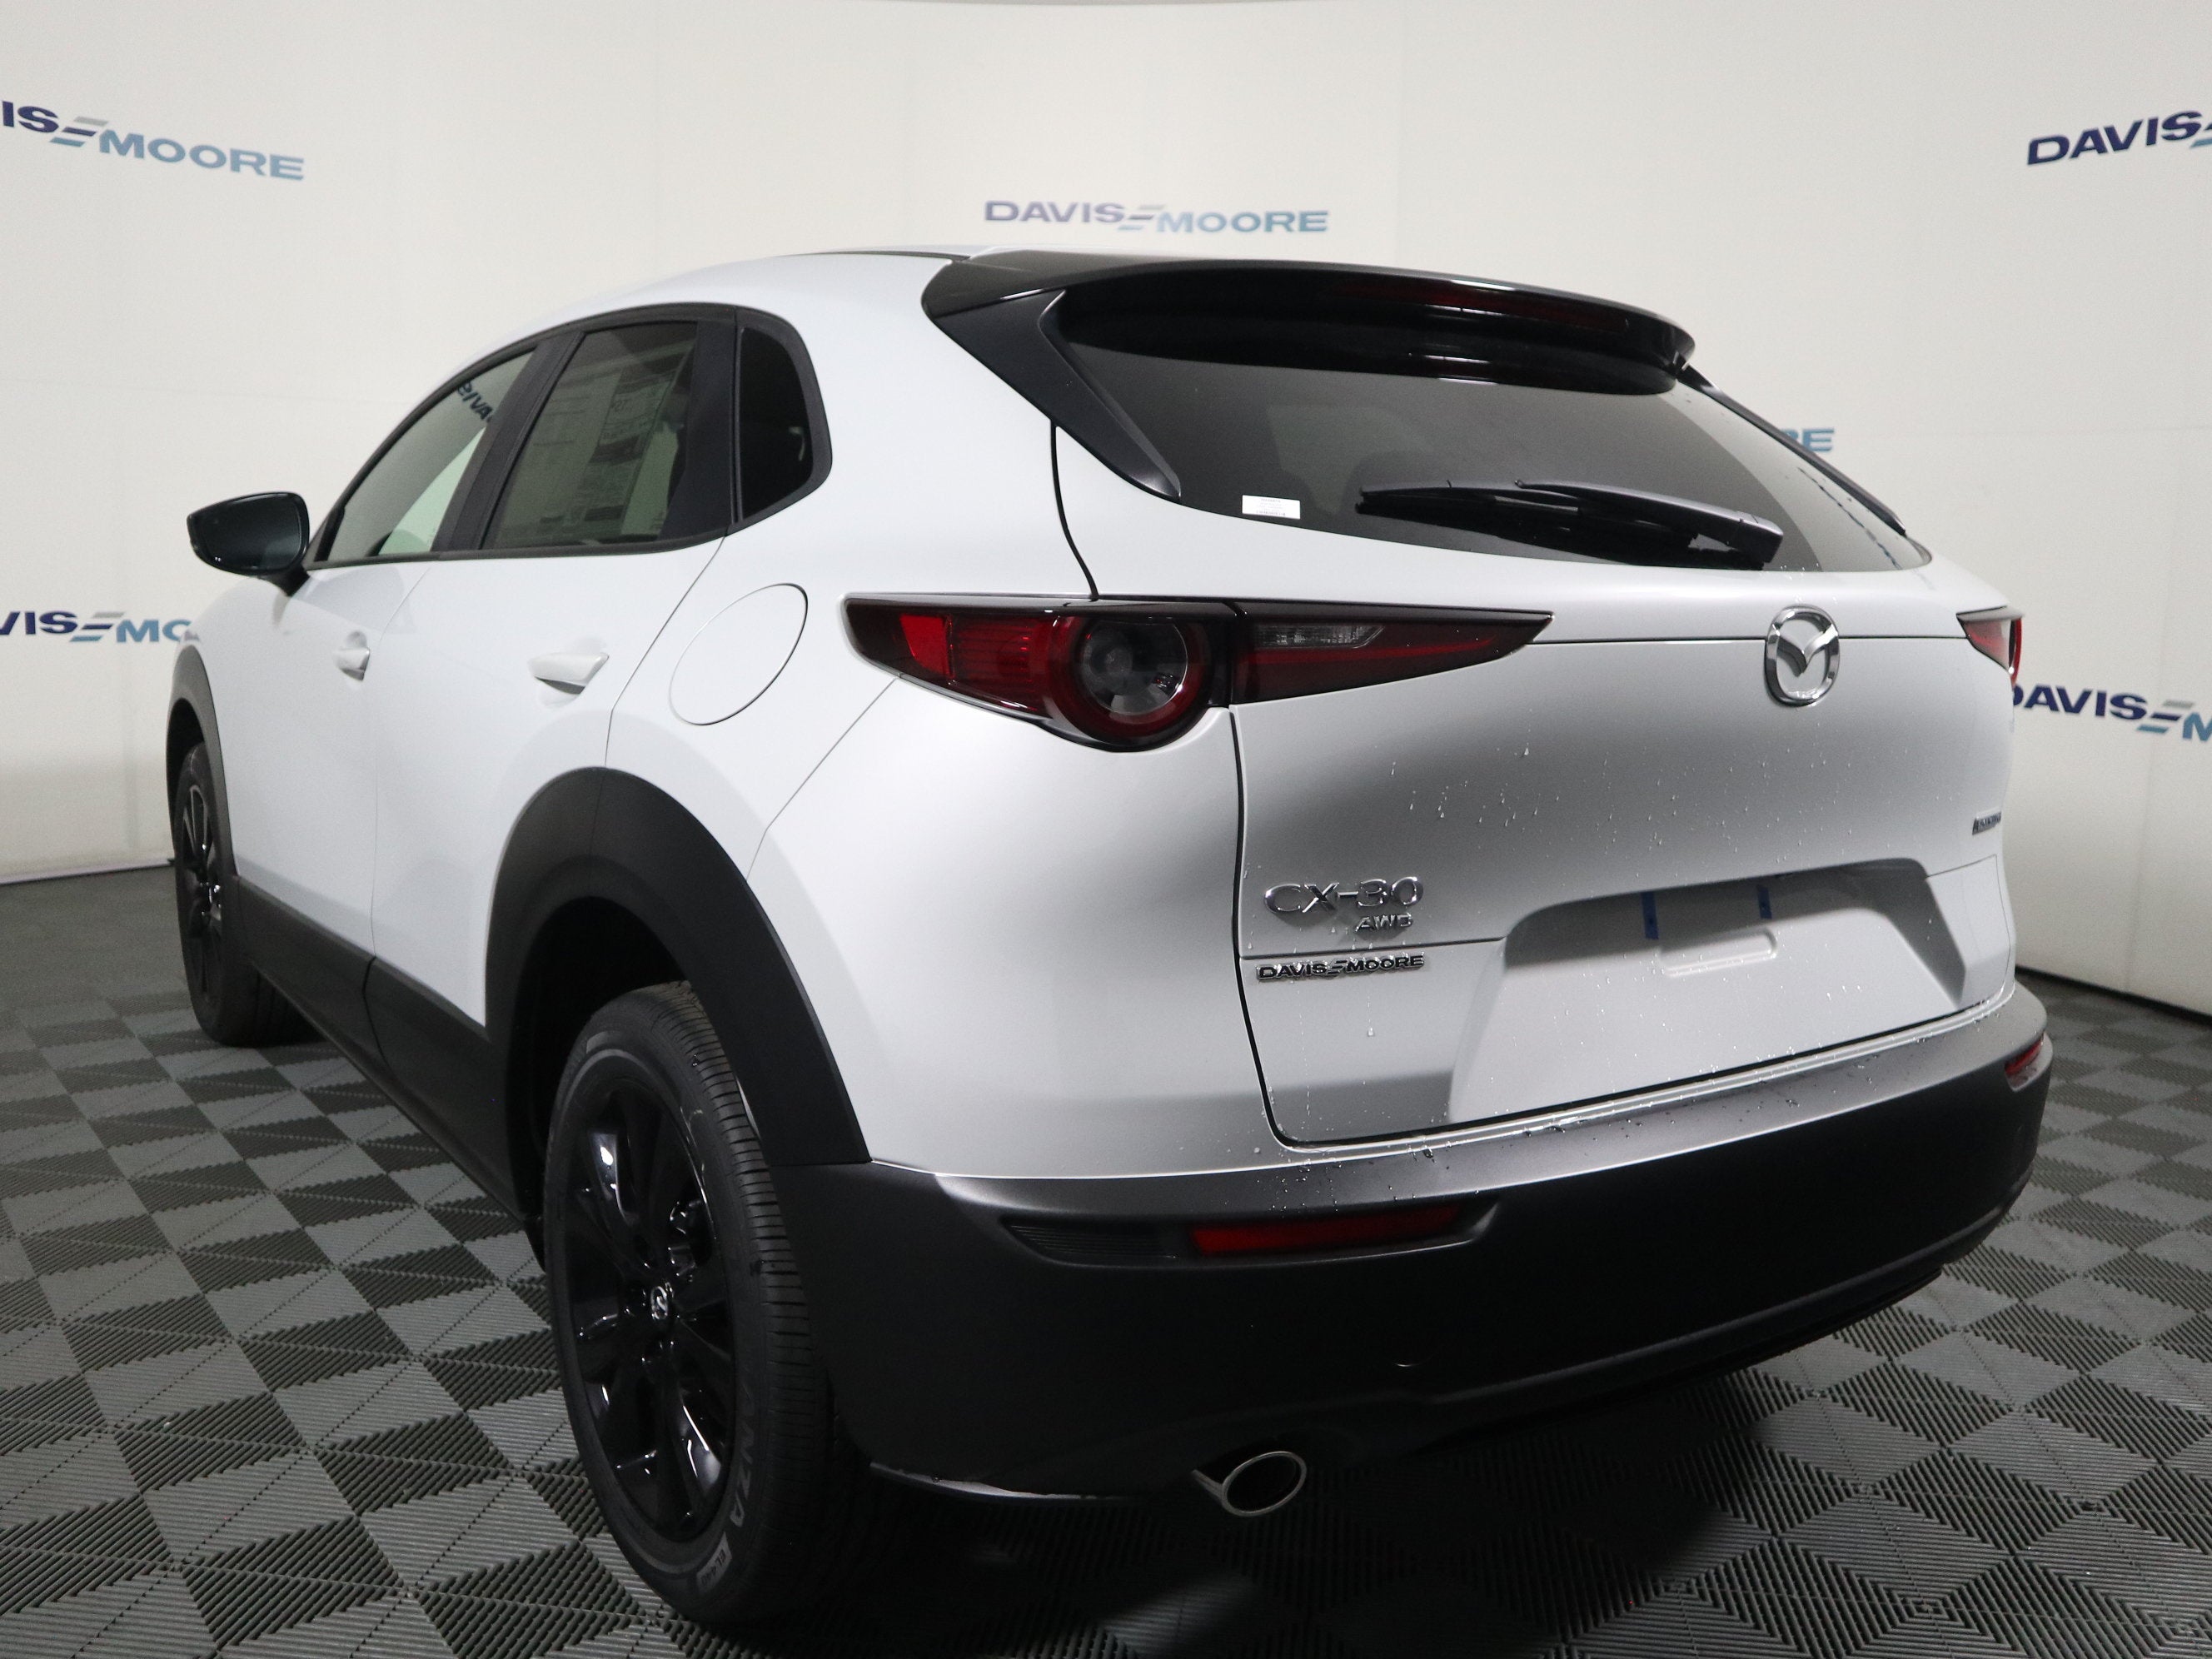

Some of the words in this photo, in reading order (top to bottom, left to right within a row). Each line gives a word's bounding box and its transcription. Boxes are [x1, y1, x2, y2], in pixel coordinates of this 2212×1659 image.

[99, 129, 305, 181] MOORE
[2027, 110, 2203, 166] DAVIS
[984, 201, 1124, 223] DAVIS
[1156, 210, 1329, 233] MOORE
[1263, 876, 1424, 914] CX-30
[1355, 912, 1415, 932] AWD
[1257, 960, 1328, 980] DAVIS
[1345, 954, 1425, 973] MOORE
